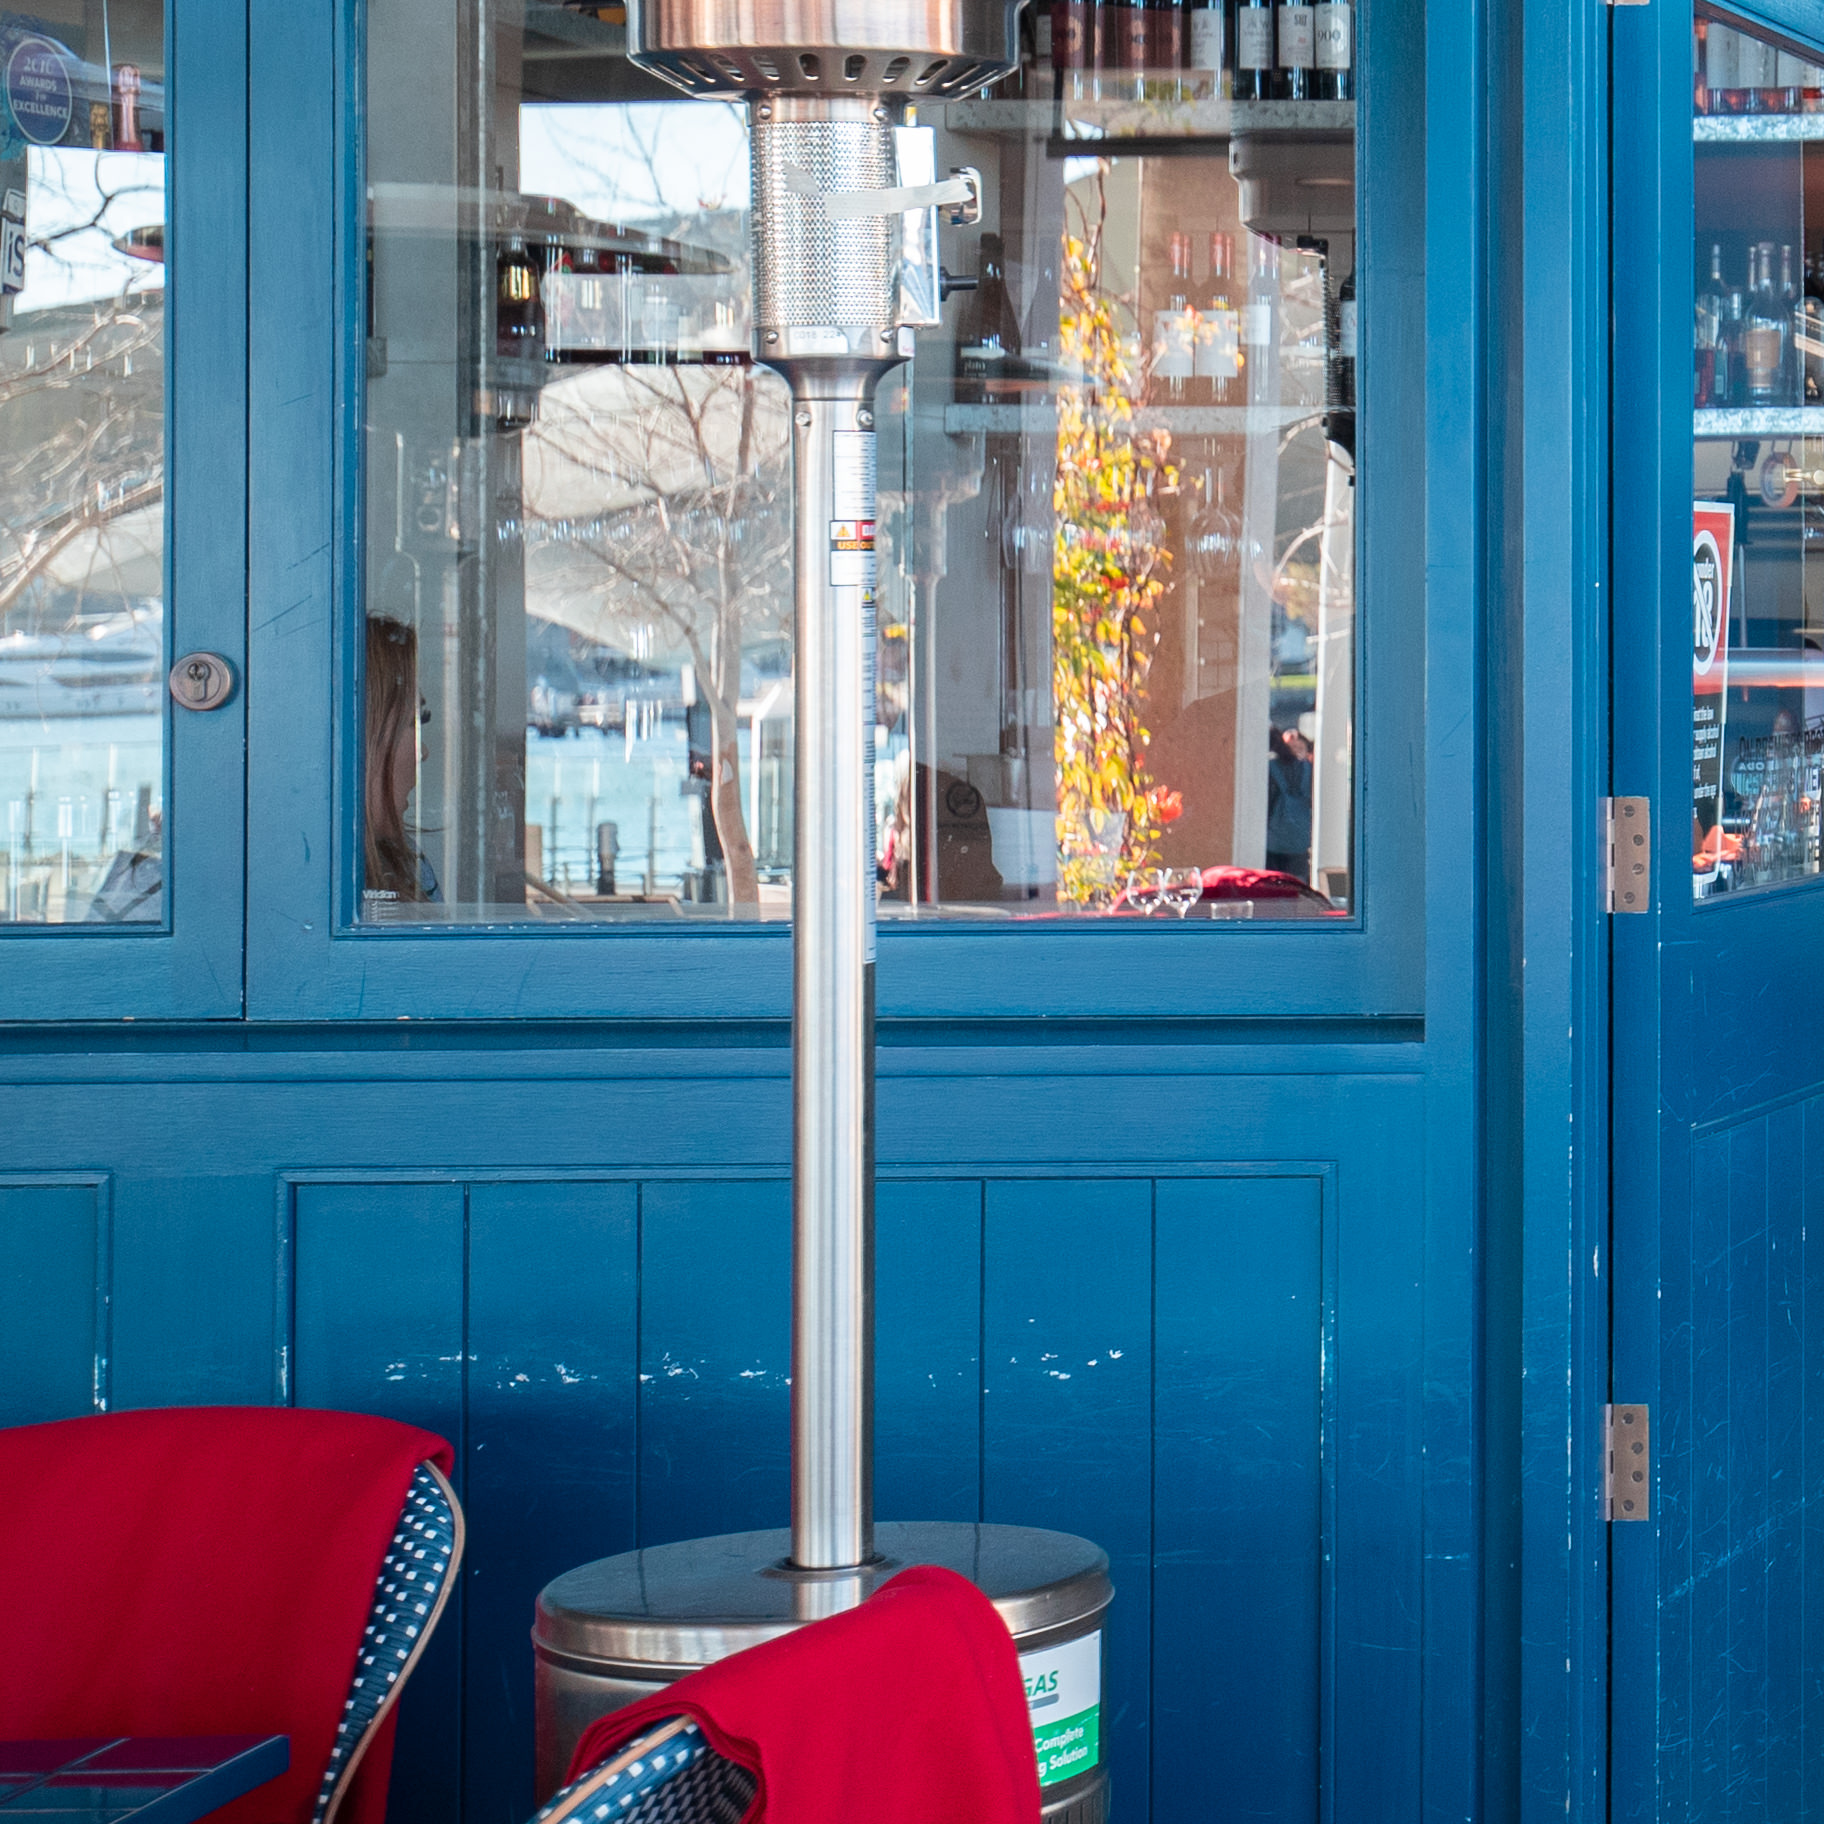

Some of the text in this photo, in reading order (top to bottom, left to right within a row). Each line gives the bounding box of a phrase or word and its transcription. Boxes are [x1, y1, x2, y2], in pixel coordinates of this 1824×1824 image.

[19, 76, 58, 93] AWARDS
[12, 98, 69, 121] EXCELLENCE
[1023, 1669, 1059, 1698] GAS
[1035, 1726, 1085, 1753] Complete
[1049, 1744, 1089, 1770] Solution
